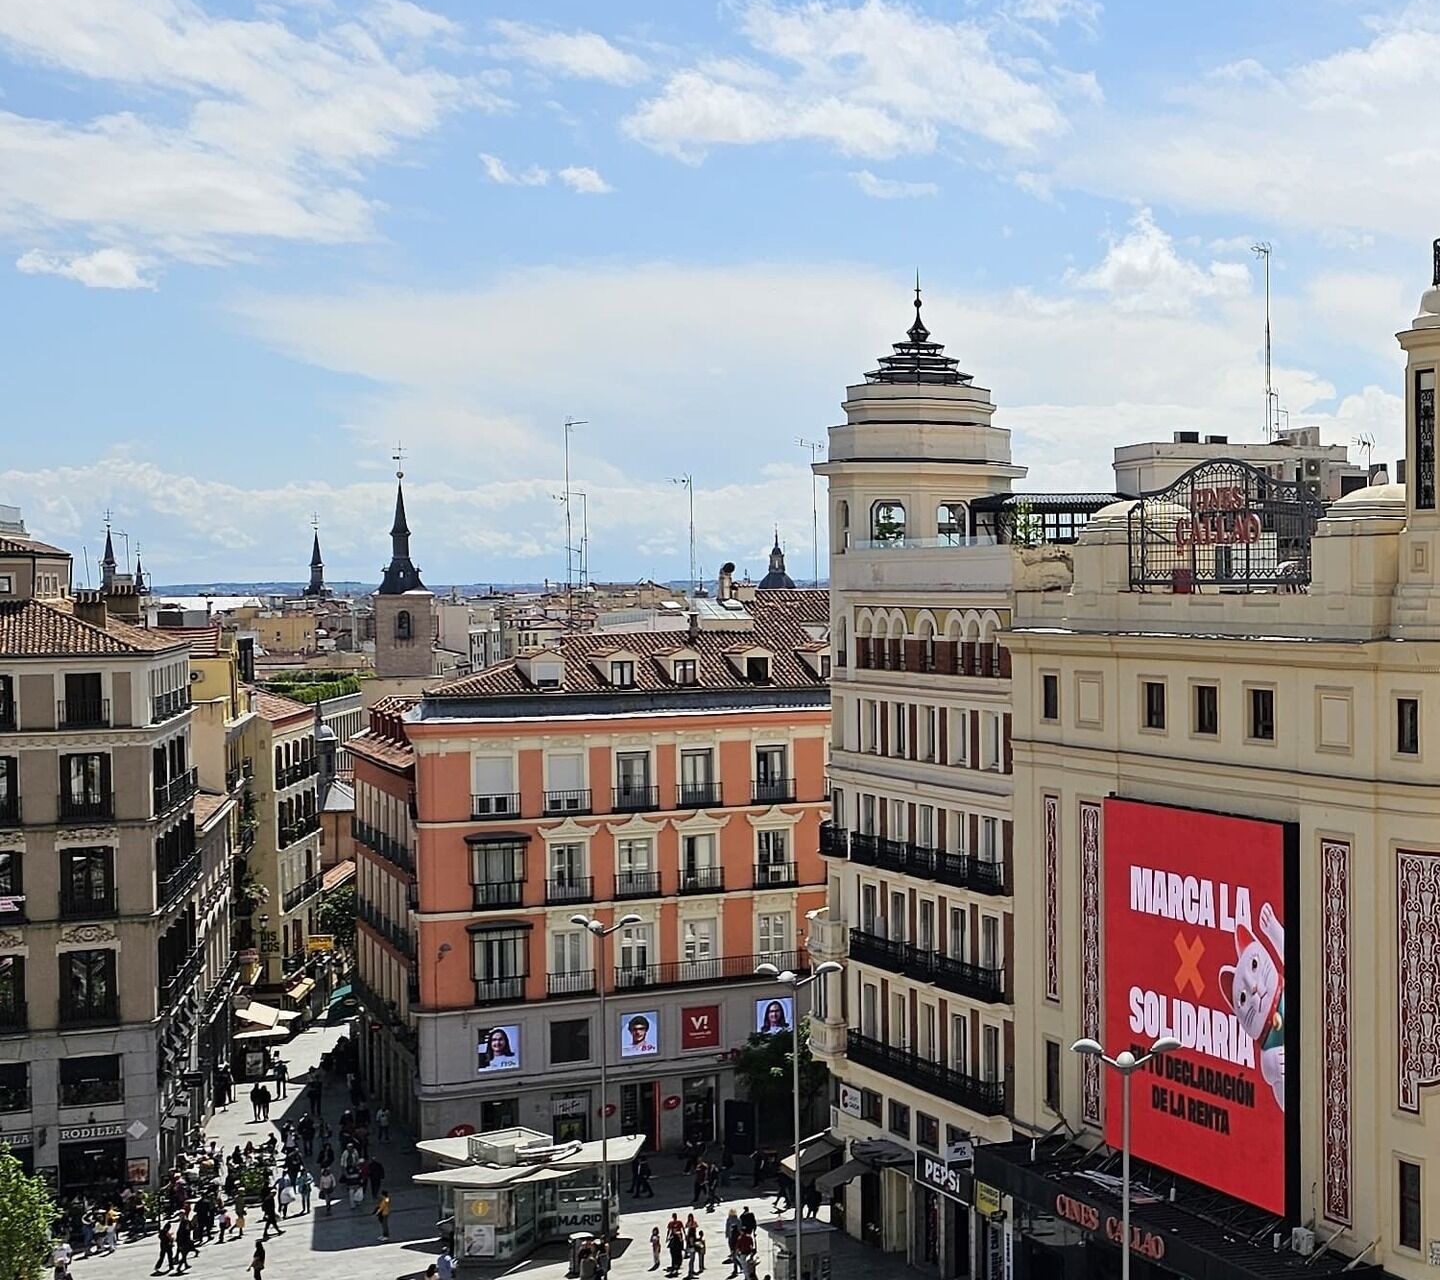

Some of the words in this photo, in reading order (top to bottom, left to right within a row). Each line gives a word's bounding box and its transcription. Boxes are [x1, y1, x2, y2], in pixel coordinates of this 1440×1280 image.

[1130, 865, 1216, 929] MARCA
[1219, 882, 1252, 933] LA
[1129, 986, 1256, 1069] SOLIDARIA
[1151, 1084, 1168, 1113] DE
[1169, 1090, 1186, 1120] LA
[1187, 1096, 1230, 1136] RENTA
[1165, 1054, 1255, 1108] DECLARACIÓN
[61, 1125, 123, 1139] RODILLA
[1056, 1193, 1100, 1231] CINES
[1106, 1216, 1165, 1260] CALAO
